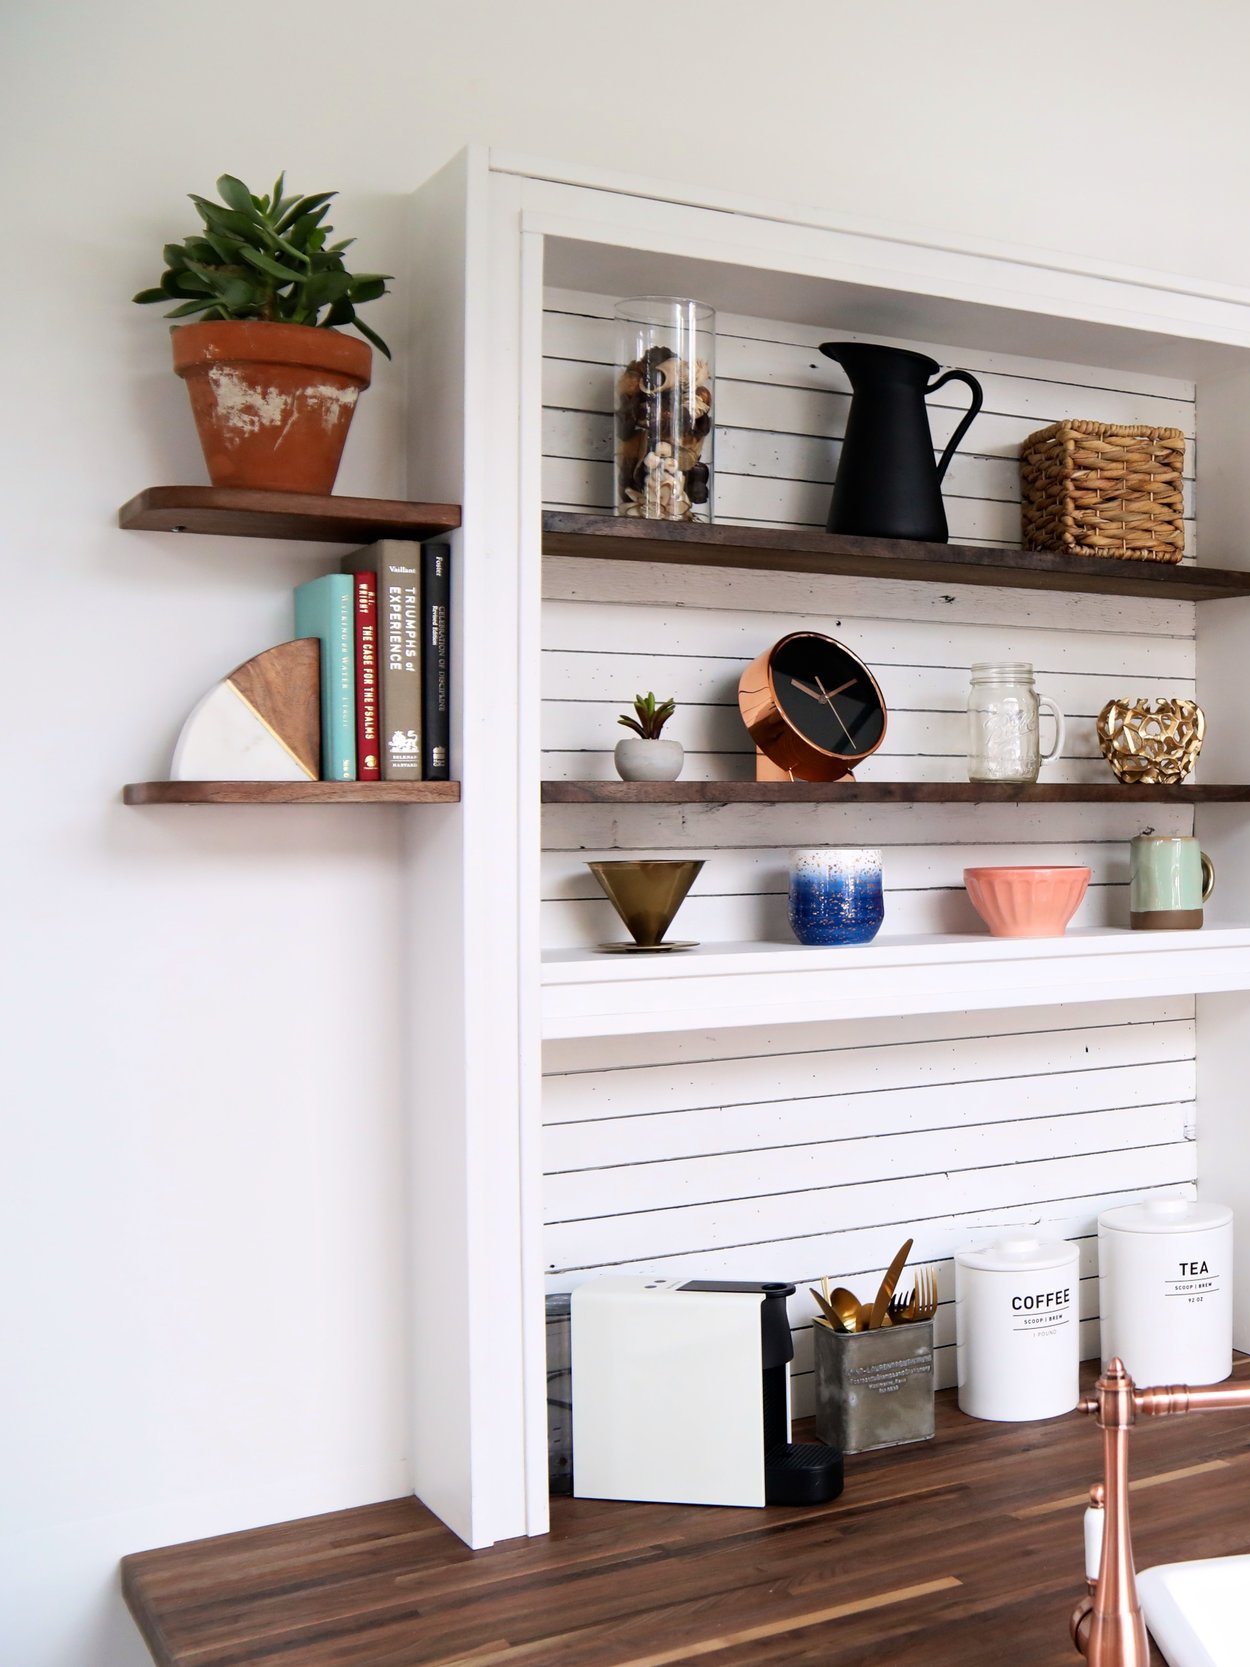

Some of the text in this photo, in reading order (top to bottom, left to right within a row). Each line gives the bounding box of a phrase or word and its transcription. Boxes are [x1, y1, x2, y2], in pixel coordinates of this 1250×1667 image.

[388, 565, 416, 574] Vaillant
[435, 556, 443, 577] Foster
[359, 583, 368, 613] WRIGHT
[389, 587, 402, 671] EXPERIENCE
[405, 587, 416, 672] TRIUMPHS of
[438, 659, 445, 668] OF
[362, 625, 375, 740] THE CASE FOR THE PSALMS
[1178, 1260, 1209, 1276] TEA
[1011, 1288, 1070, 1310] COFFEE
[1023, 1314, 1063, 1325] SCOOP BREW
[1037, 1329, 1057, 1337] POUND
